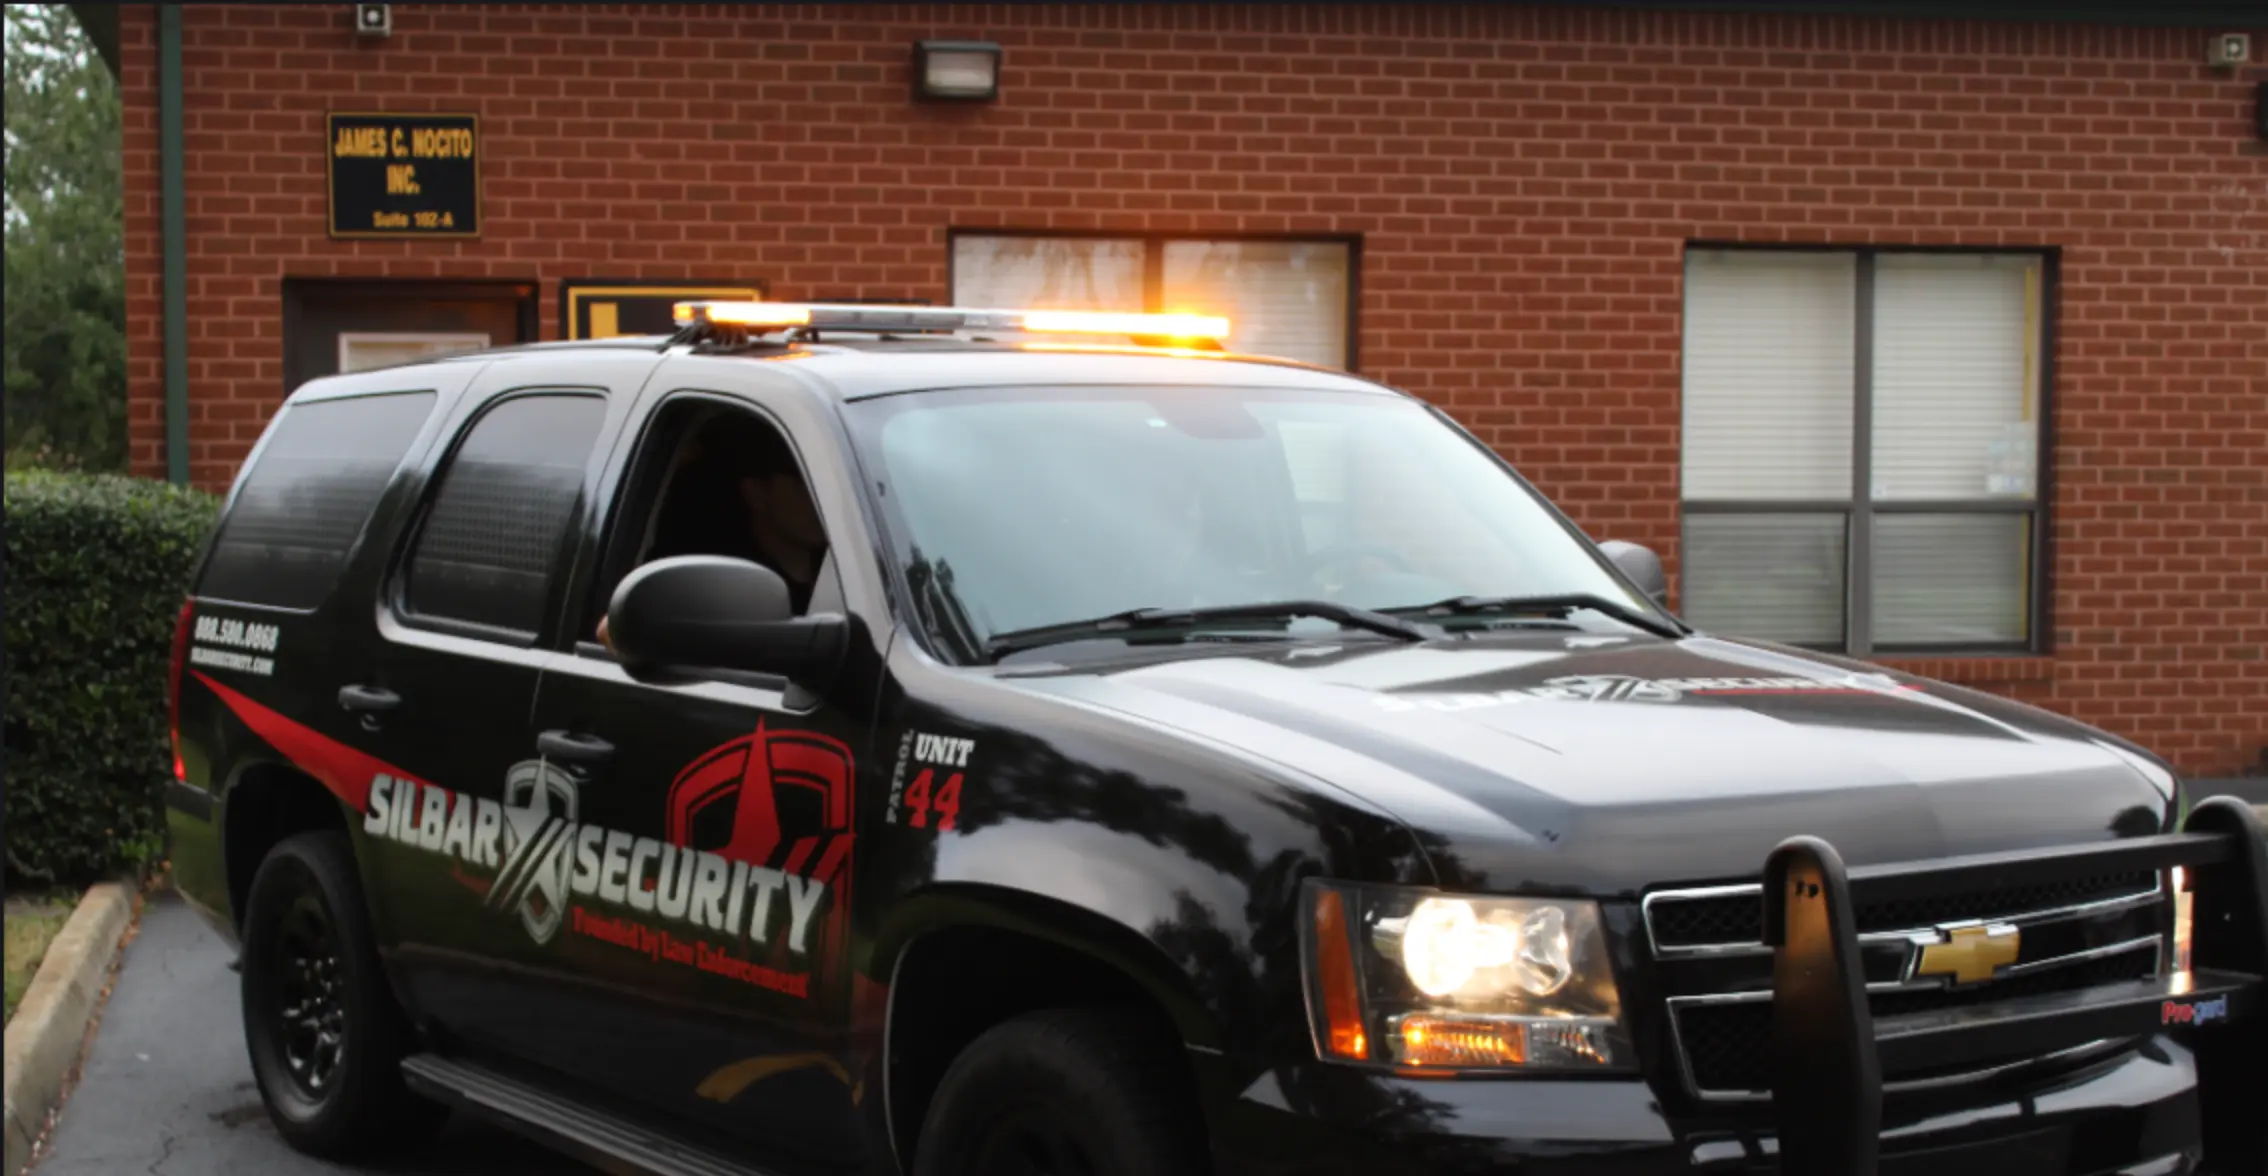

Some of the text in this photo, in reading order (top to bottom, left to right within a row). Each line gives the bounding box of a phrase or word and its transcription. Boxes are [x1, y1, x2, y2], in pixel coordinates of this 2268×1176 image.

[335, 127, 473, 158] JAMES C. NOCITO
[386, 164, 421, 194] INC.
[373, 210, 409, 228] Suite
[914, 732, 976, 767] UNIT
[886, 728, 915, 823] PATROL
[904, 768, 964, 831] 44
[363, 772, 824, 954] SILBAR SECURITY
[571, 905, 809, 999] Founded by Law Enforcement
